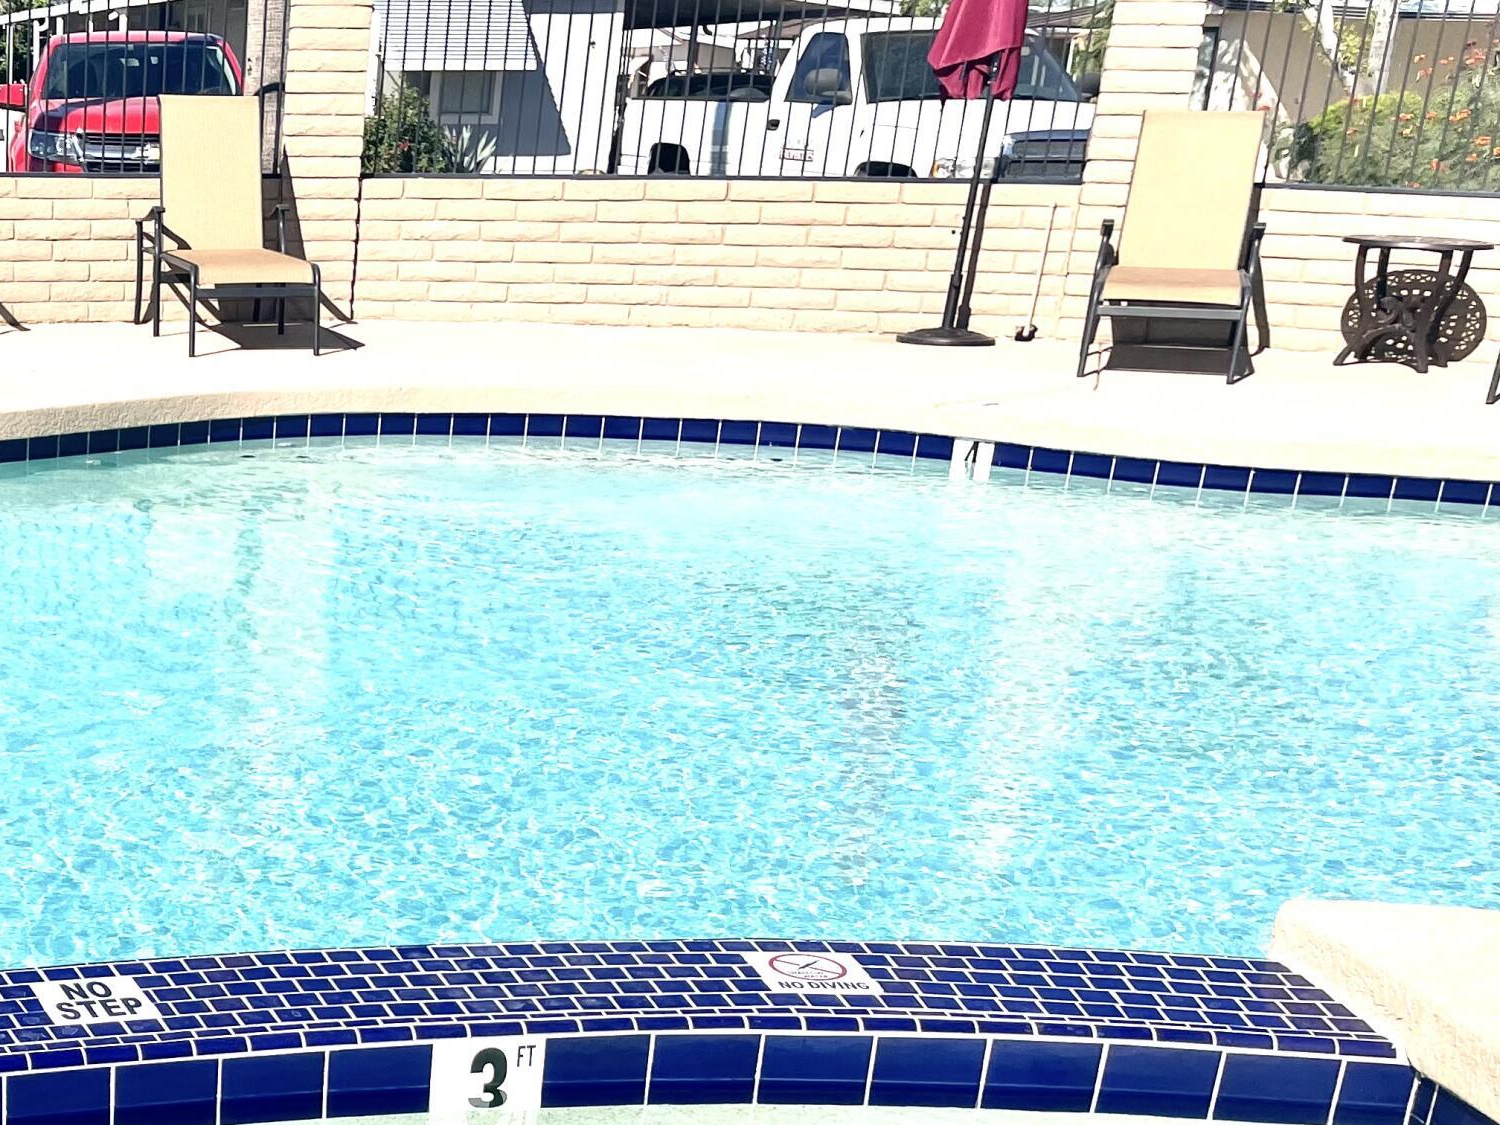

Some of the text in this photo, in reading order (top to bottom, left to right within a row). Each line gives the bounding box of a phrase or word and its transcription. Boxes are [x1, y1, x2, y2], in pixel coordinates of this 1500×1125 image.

[59, 981, 113, 1000] NO
[778, 981, 870, 990] NO DIVING
[56, 997, 142, 1020] STEP
[467, 1045, 537, 1108] 3 FT
